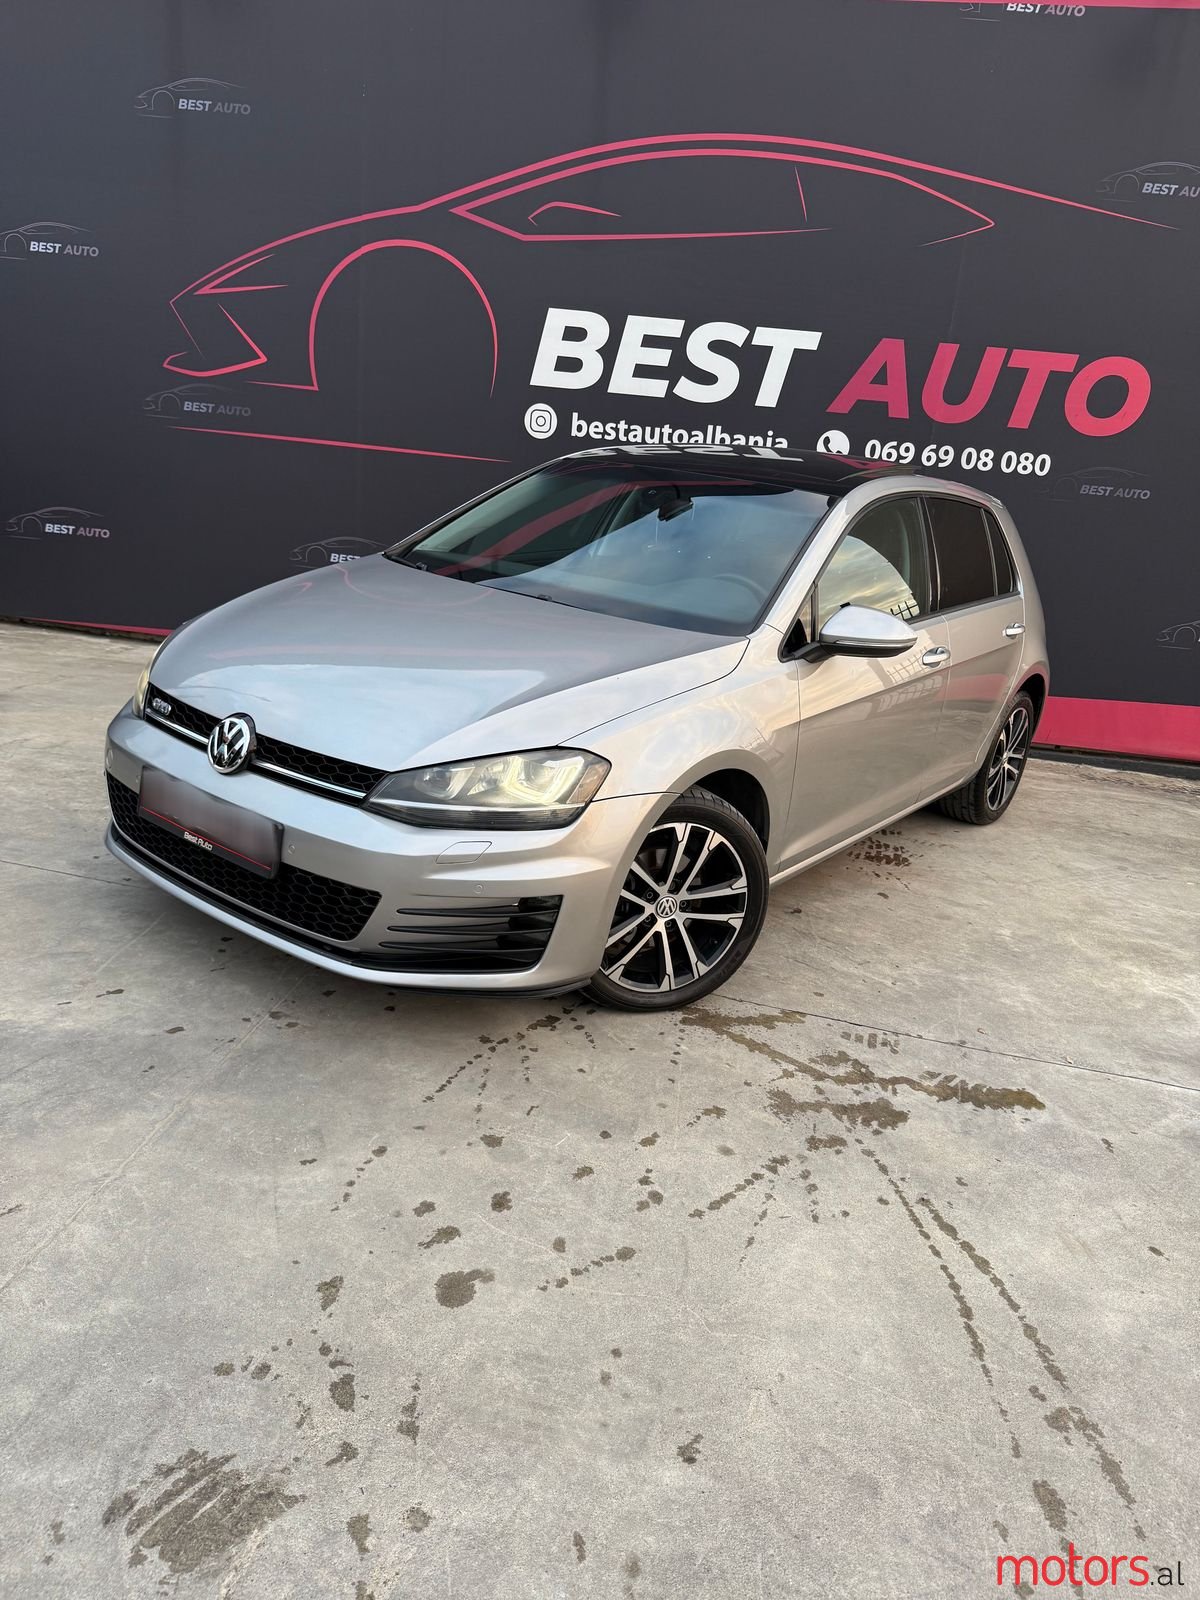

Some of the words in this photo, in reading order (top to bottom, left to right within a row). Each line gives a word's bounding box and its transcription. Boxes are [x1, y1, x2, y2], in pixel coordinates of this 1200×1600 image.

[1006, 3, 1041, 13] BEST
[1044, 5, 1085, 17] AUTO
[178, 98, 212, 112] BEST
[213, 102, 251, 115] AUTO
[1142, 182, 1178, 196] BEST
[29, 241, 62, 254] BEST
[63, 244, 99, 257] AUTO
[529, 307, 822, 407] BEST
[825, 337, 1152, 436] AUTO
[183, 401, 216, 413] BEST
[216, 405, 251, 417] AUTO
[570, 411, 788, 449] bestautoalbania
[865, 439, 916, 464] 069
[921, 444, 954, 468] 69
[960, 447, 995, 472] 08
[1000, 450, 1051, 477] 080
[1080, 484, 1113, 496] BEST
[1114, 487, 1151, 500] AUTO
[45, 523, 75, 535] BEST
[76, 526, 110, 538] AUTO
[184, 832, 199, 844] Best
[198, 838, 213, 851] Auto
